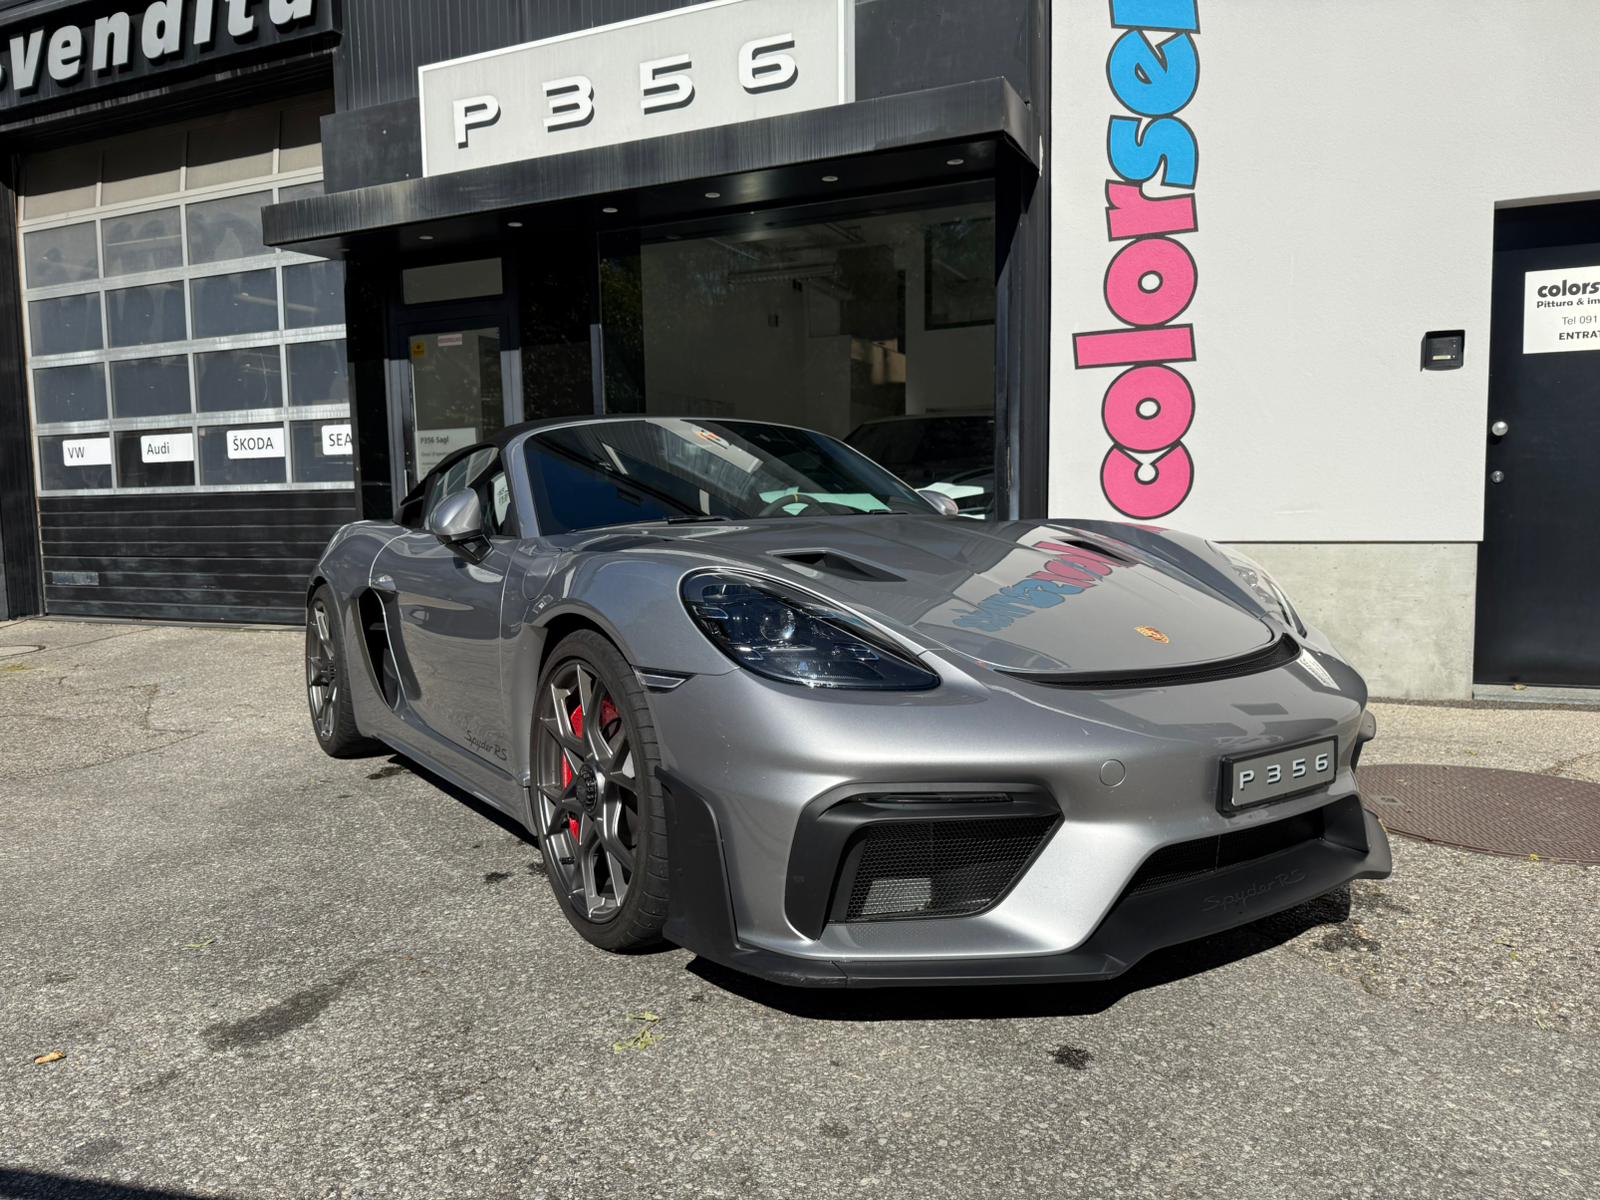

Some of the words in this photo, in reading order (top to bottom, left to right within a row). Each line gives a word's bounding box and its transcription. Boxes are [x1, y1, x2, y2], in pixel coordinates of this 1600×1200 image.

[1562, 316, 1576, 326] Tel
[1579, 315, 1597, 325] 091
[146, 441, 170, 455] Audi
[233, 436, 274, 452] ŠKODA
[67, 446, 85, 459] VW
